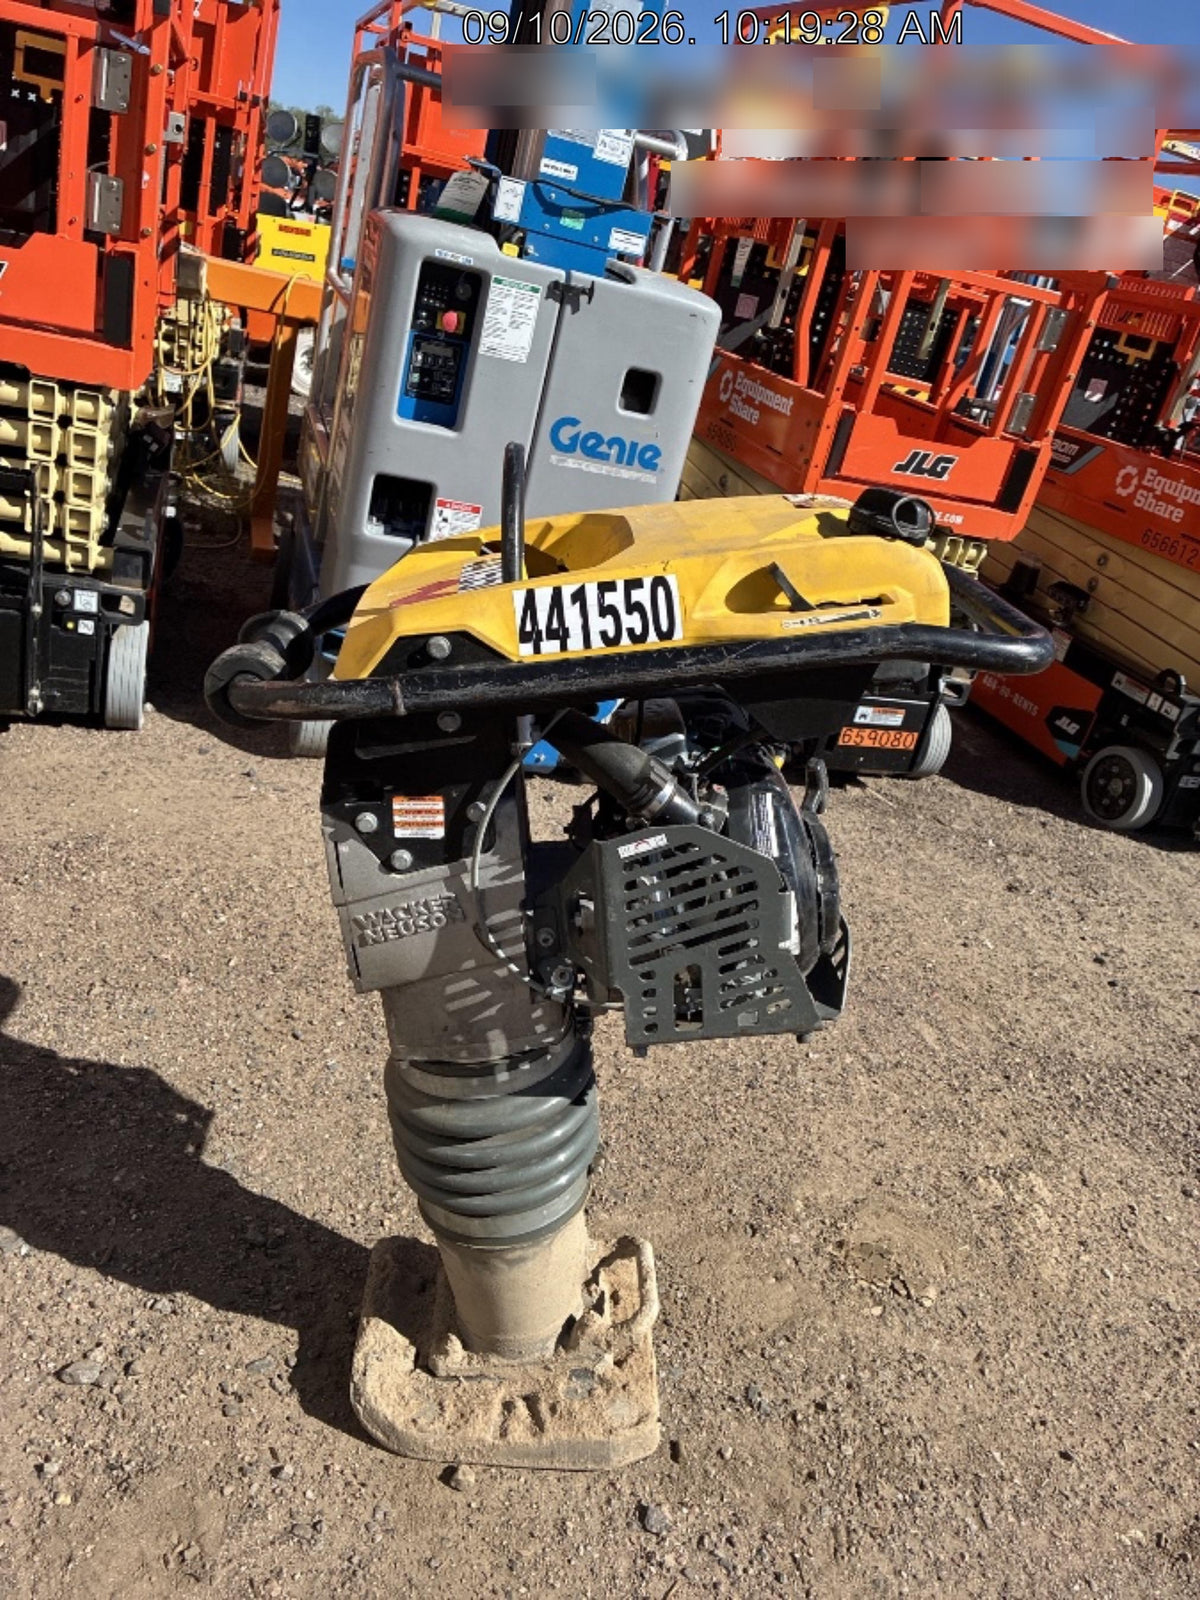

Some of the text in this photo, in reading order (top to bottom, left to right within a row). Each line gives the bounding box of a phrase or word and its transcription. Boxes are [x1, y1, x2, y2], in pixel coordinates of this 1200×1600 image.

[729, 394, 760, 426] Share
[734, 371, 794, 416] Equipment
[549, 416, 662, 472] Genie
[891, 449, 959, 481] JLG
[1133, 489, 1185, 523] Share
[1141, 528, 1199, 565] 656612
[518, 575, 676, 654] 441550
[841, 728, 915, 748] 659080
